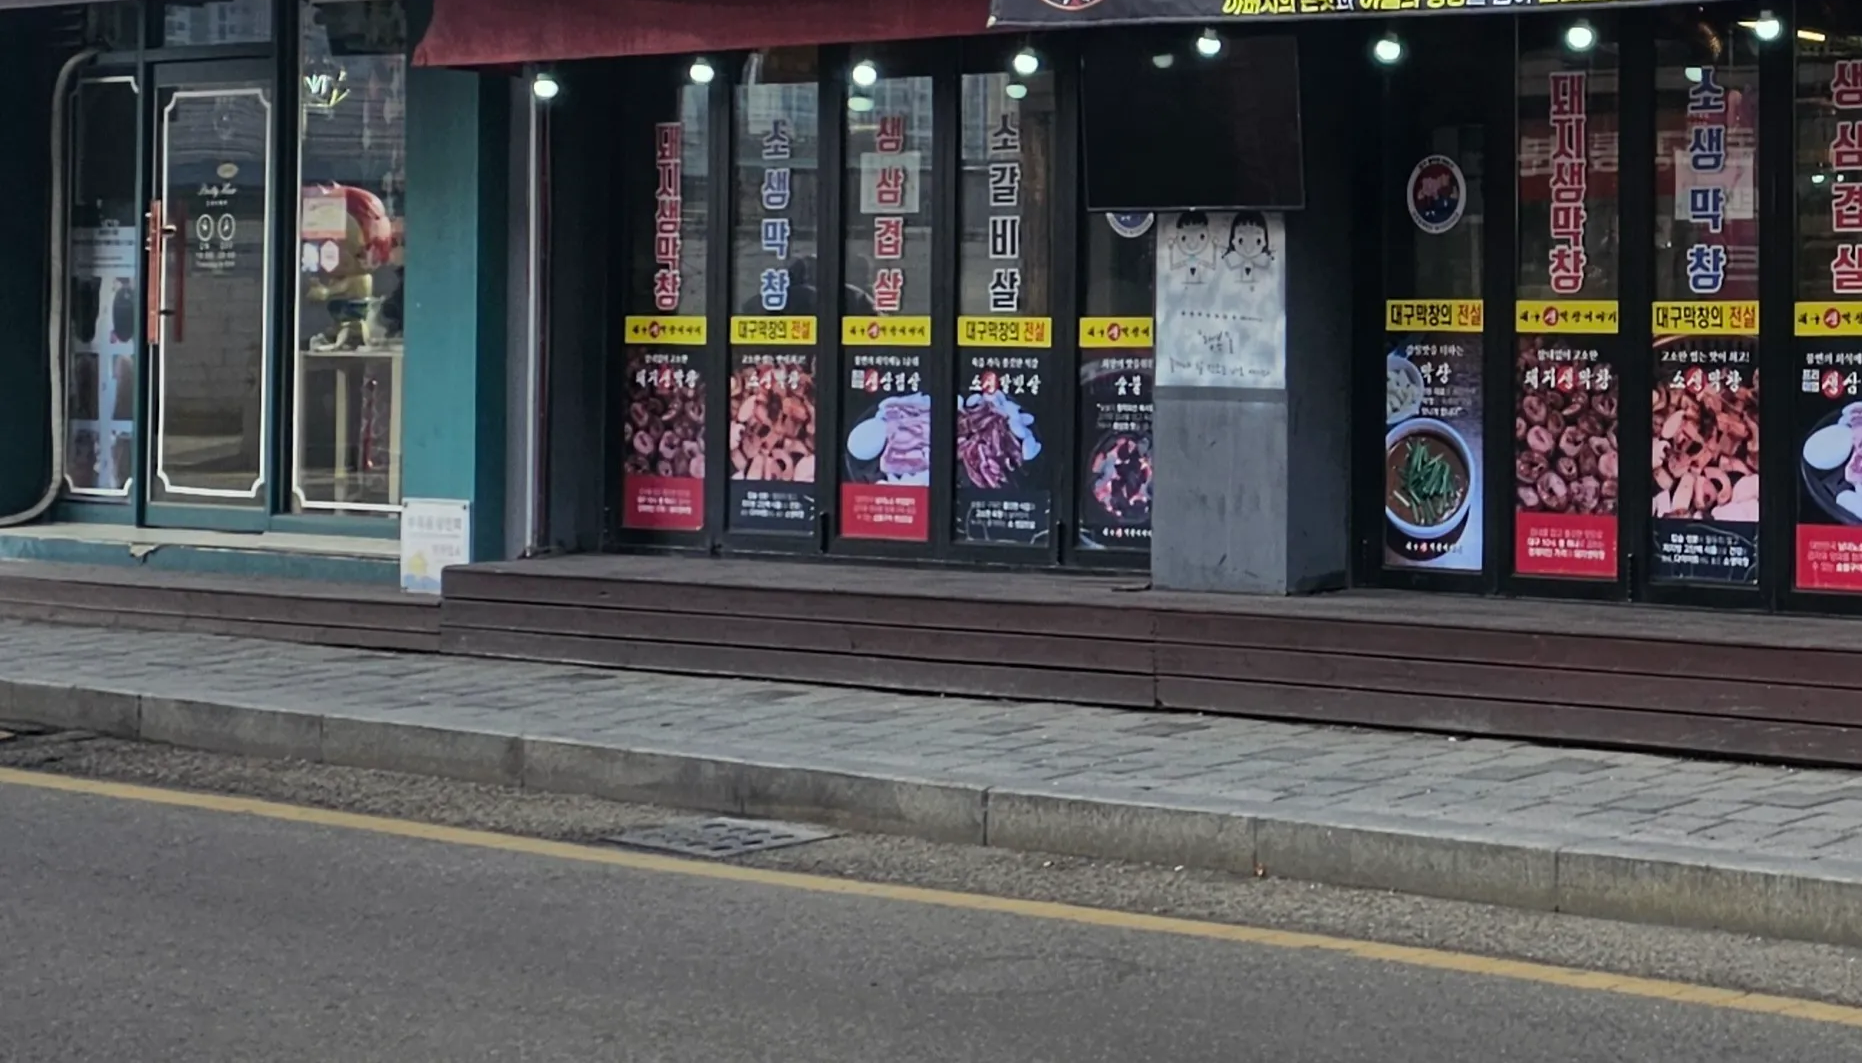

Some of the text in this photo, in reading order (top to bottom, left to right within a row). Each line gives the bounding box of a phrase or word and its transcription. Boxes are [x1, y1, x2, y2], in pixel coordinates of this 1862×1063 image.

[655, 121, 683, 312] 돼지생막창
[760, 118, 791, 312] 소생막창
[872, 114, 905, 312] 생삼겹살
[987, 113, 1022, 313] 소갈비살
[1549, 70, 1587, 294] 돼지생막창
[1686, 65, 1726, 294] 소생막창
[738, 321, 788, 340] 대구막창의
[966, 321, 1045, 342] 대구막창의 전설
[1391, 304, 1482, 327] 대구막창의 전설
[1656, 305, 1756, 330] 대구막창의 전설
[1524, 366, 1613, 391] 돼지생막창
[1669, 367, 1743, 393] 소생막창
